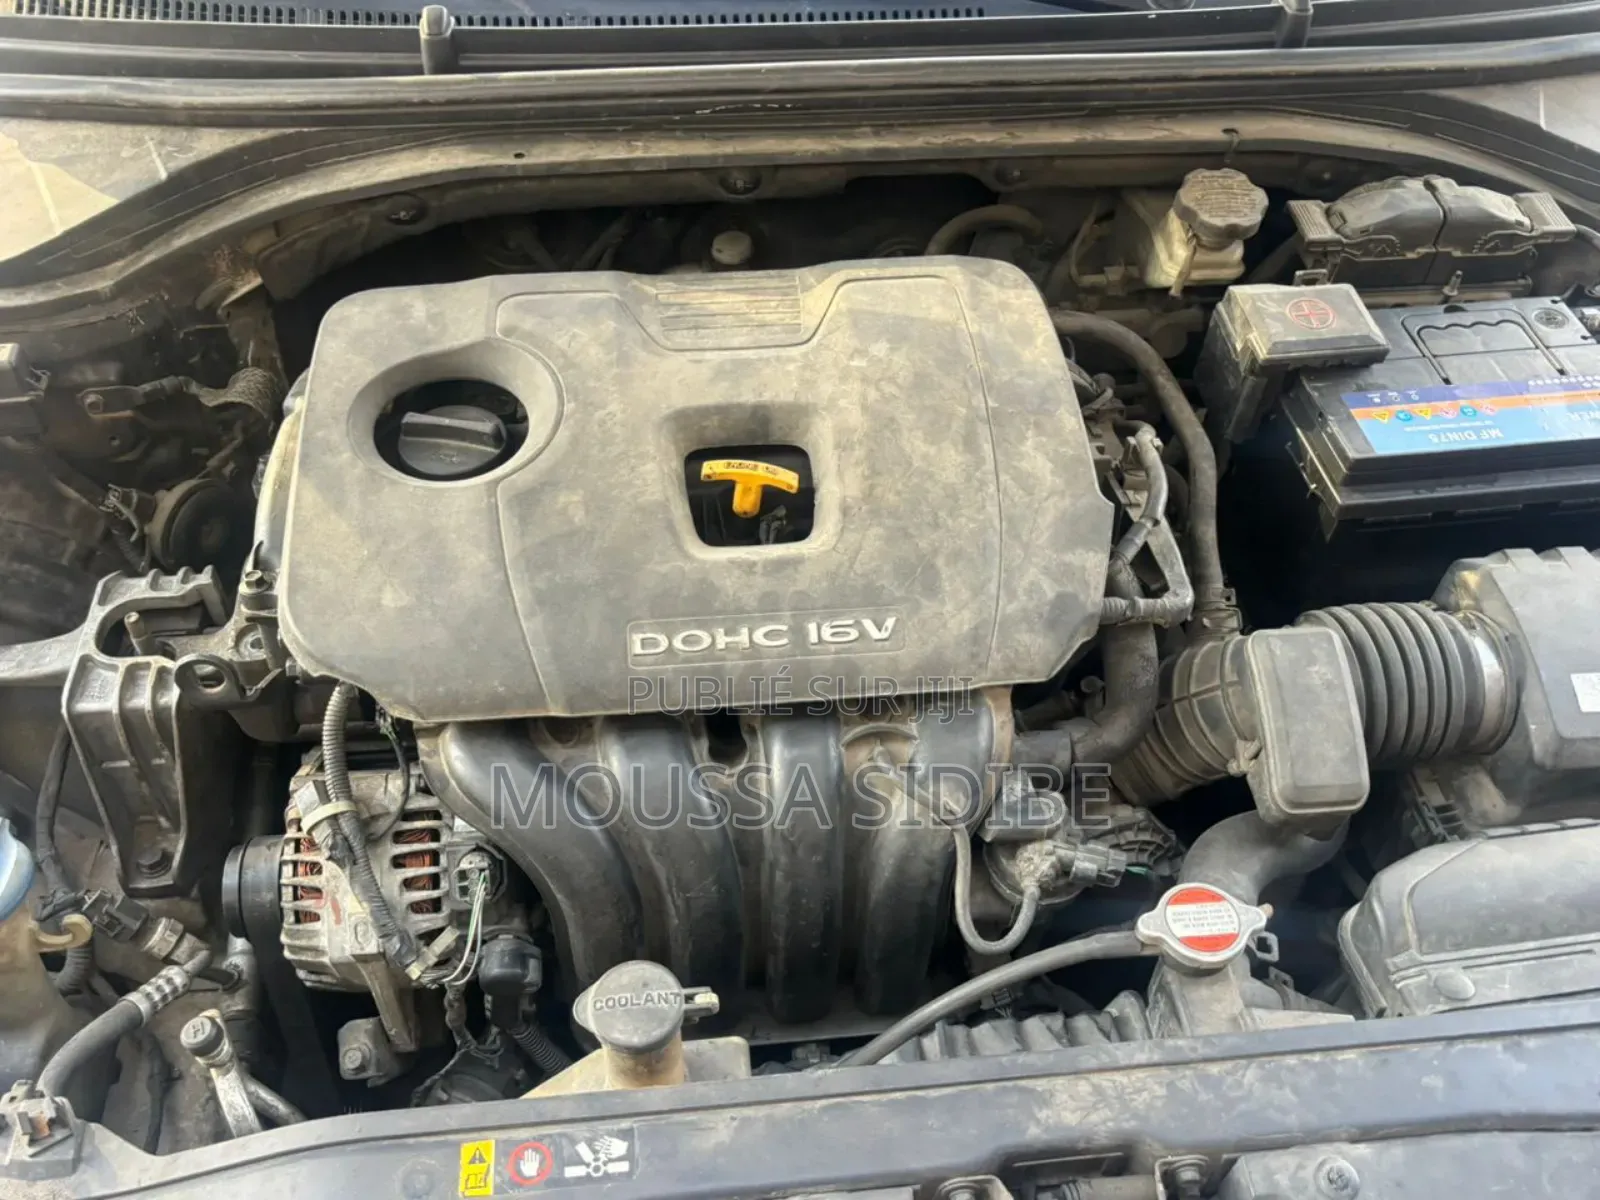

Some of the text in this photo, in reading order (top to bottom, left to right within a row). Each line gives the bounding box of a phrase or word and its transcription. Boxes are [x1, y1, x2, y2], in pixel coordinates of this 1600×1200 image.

[631, 616, 898, 656] DOHC 16V
[593, 992, 683, 1012] COOLANT
